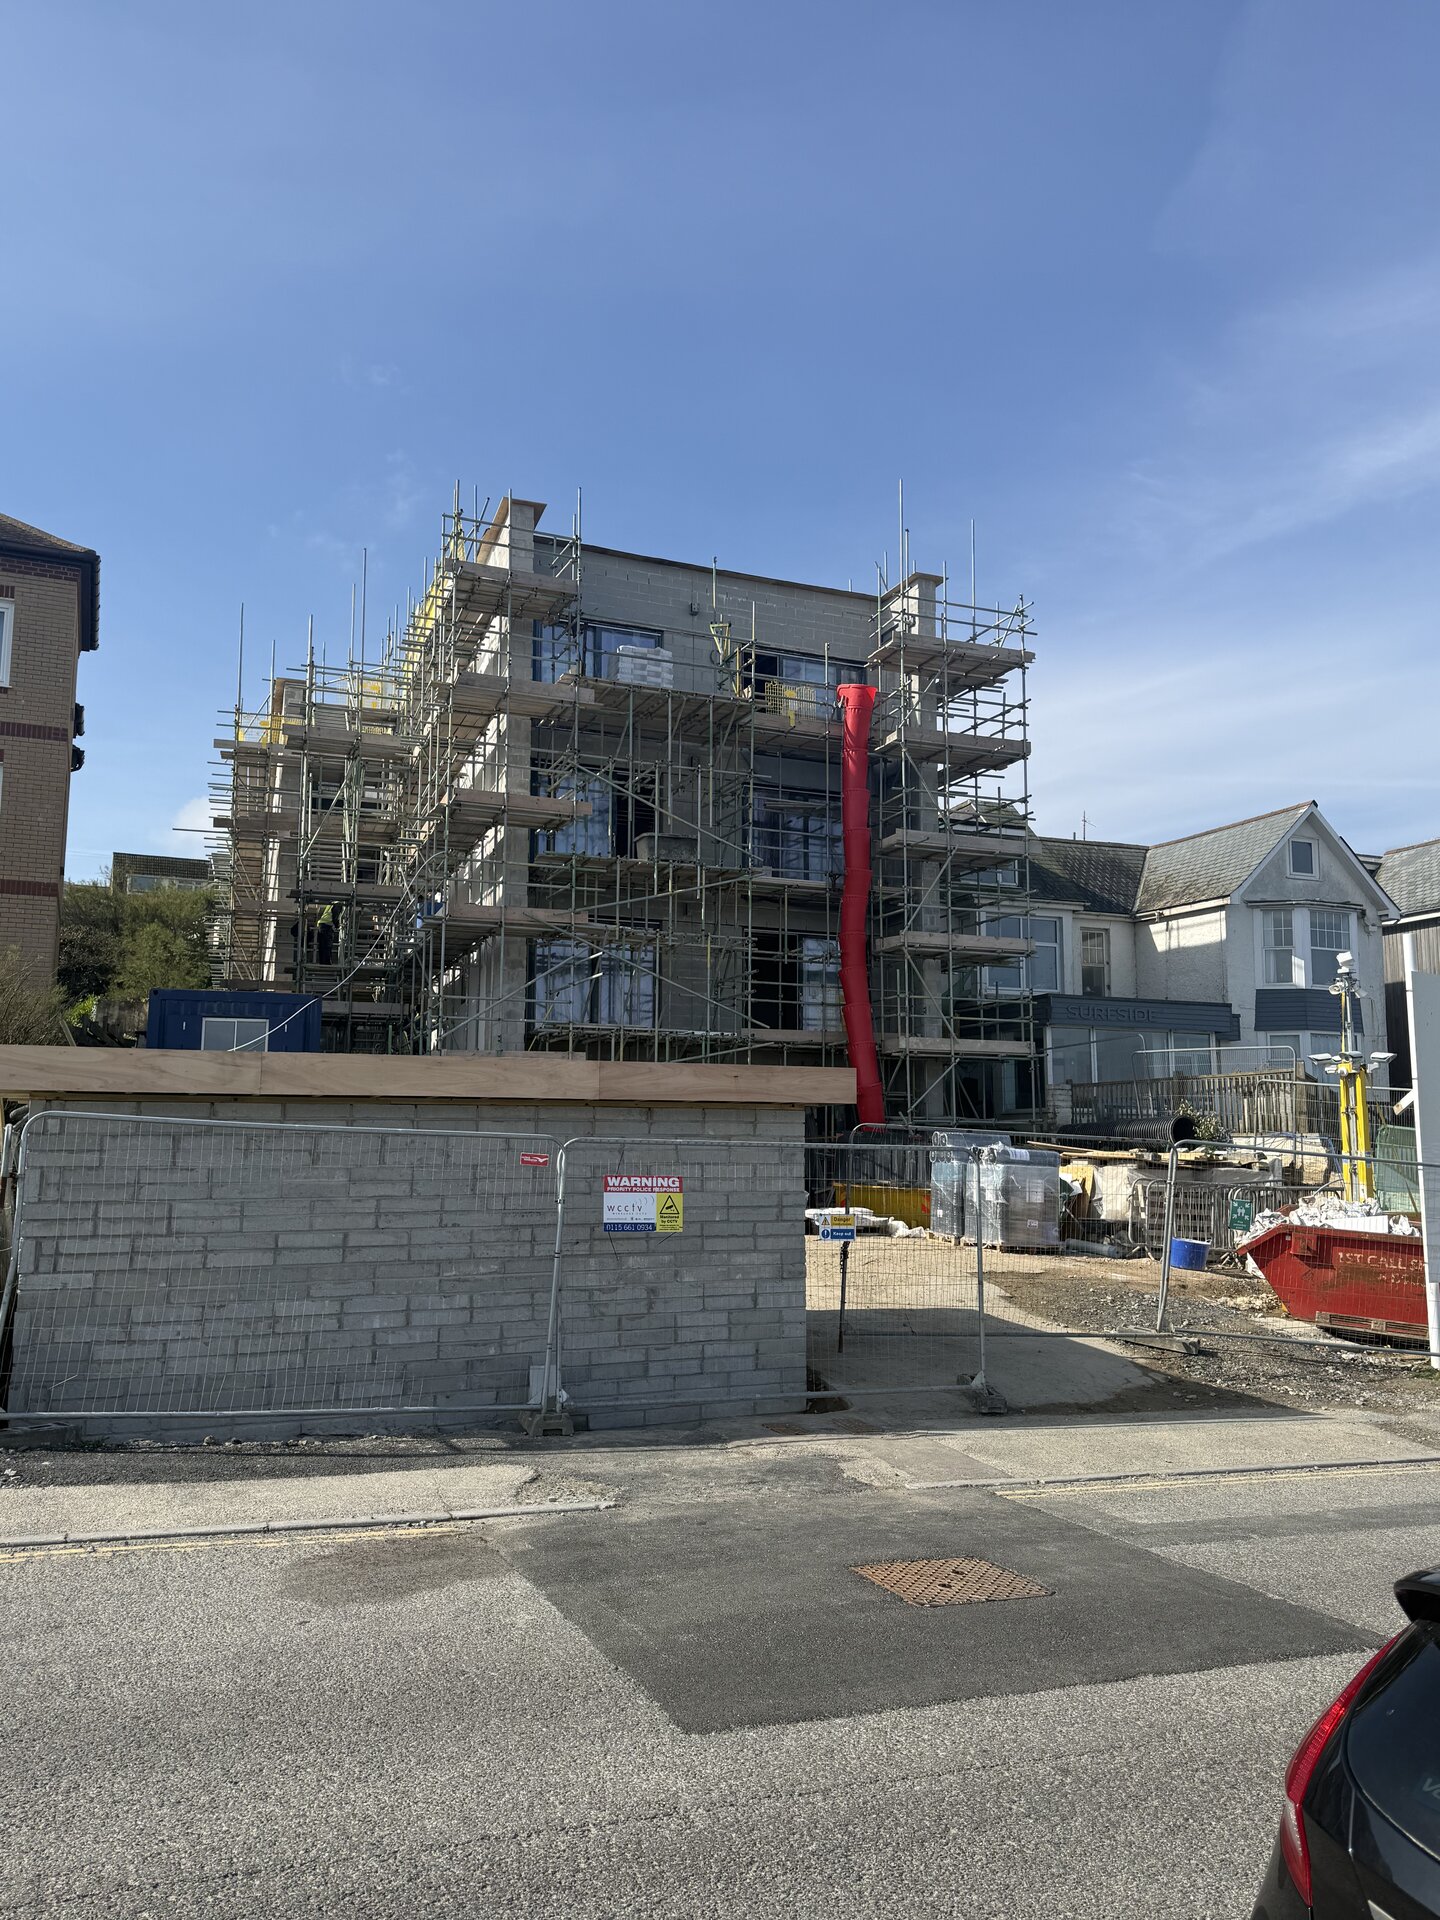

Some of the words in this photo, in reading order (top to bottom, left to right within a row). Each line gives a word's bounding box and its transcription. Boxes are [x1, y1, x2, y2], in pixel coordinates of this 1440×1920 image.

[1066, 1004, 1155, 1022] SURFSIDE
[607, 1177, 680, 1187] WARNING
[607, 1203, 643, 1212] wcctv
[1367, 1255, 1407, 1270] CALL
